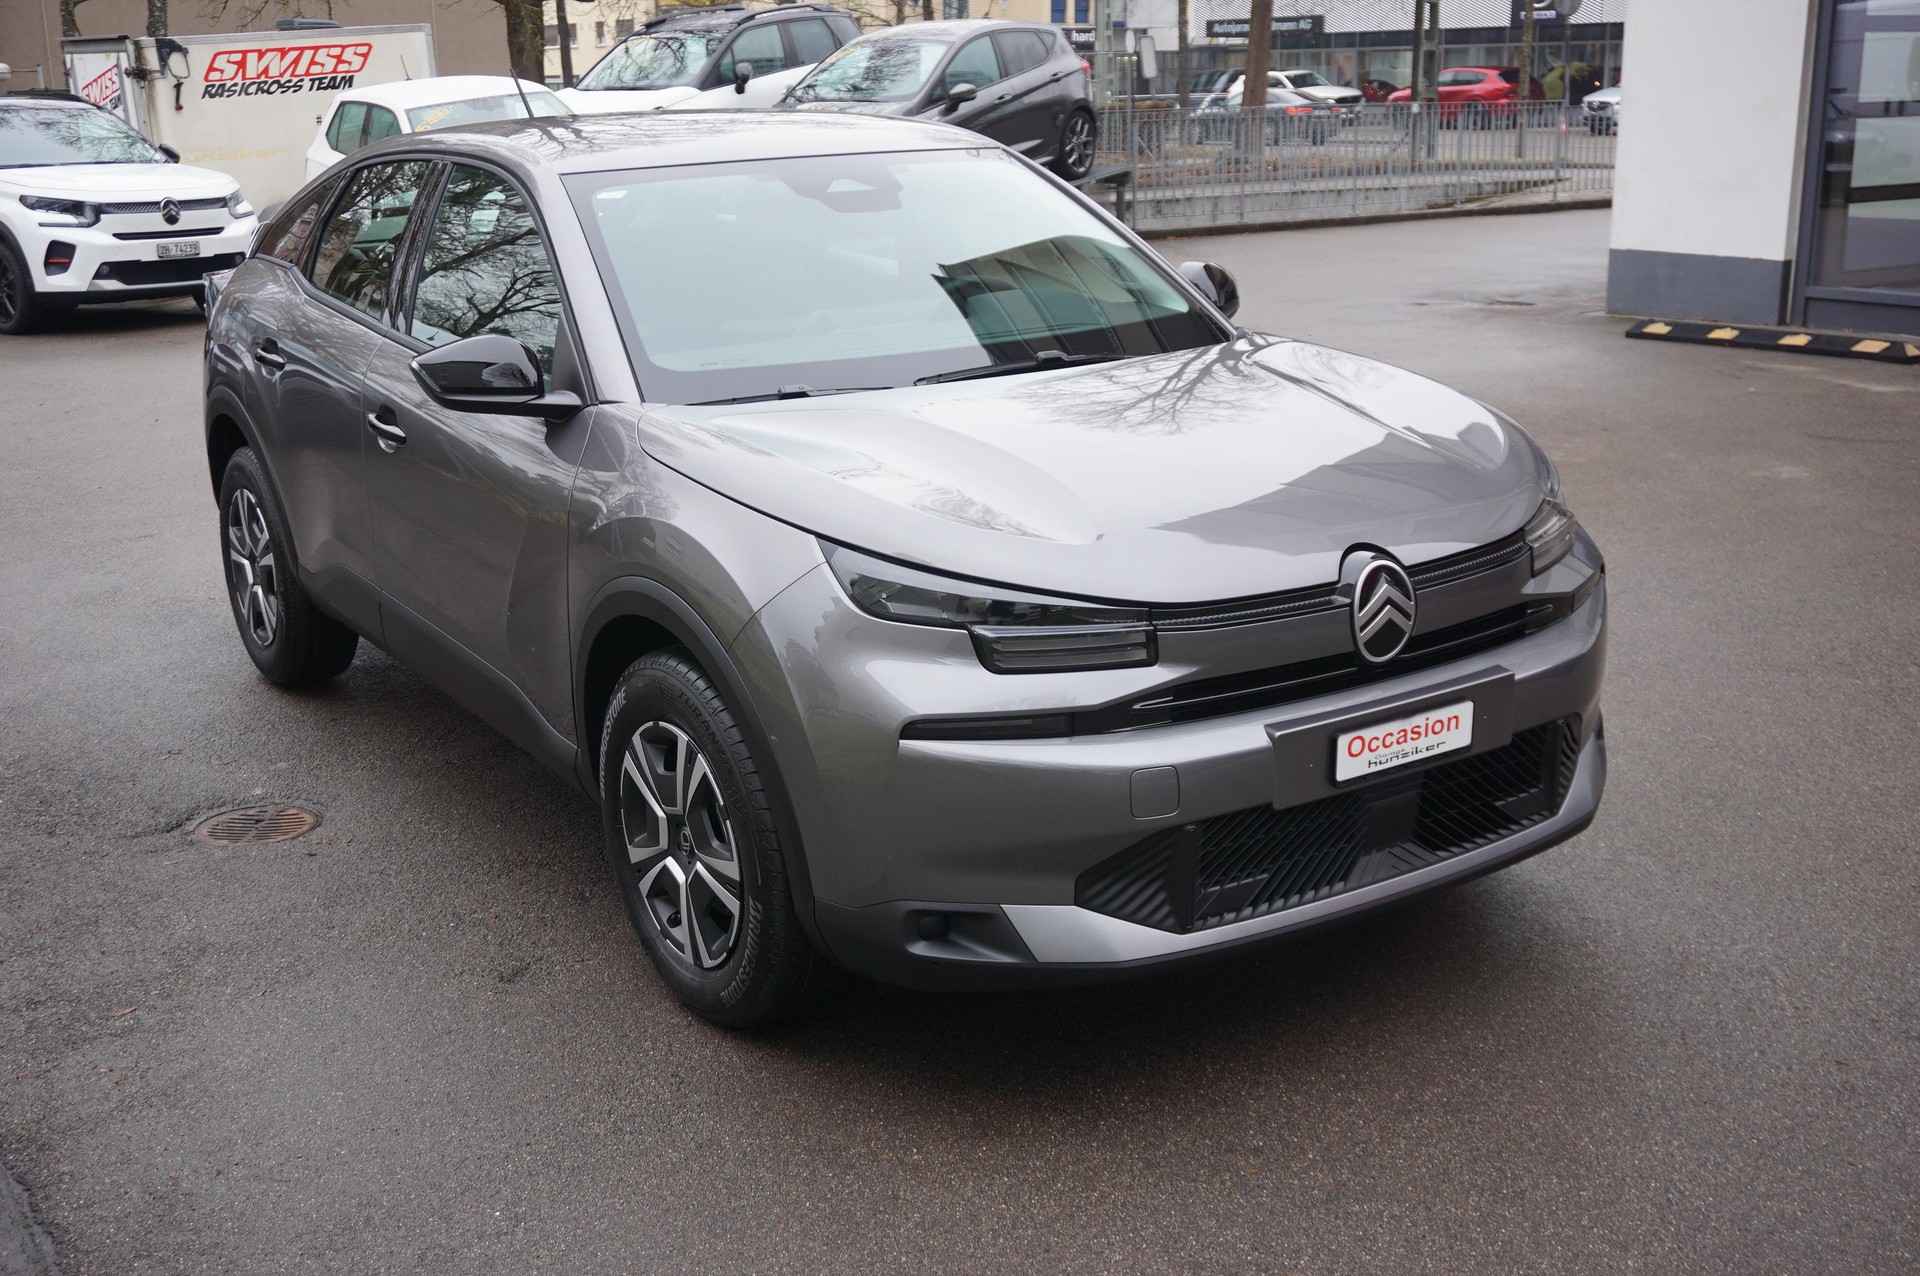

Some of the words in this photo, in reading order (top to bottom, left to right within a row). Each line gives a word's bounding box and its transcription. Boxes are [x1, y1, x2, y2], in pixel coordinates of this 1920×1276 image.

[204, 44, 373, 83] SWISS
[201, 78, 303, 100] RASICROSS
[308, 75, 355, 92] TEAM
[600, 686, 627, 801] BRIDGESTONE
[1347, 714, 1460, 758] Occasion
[1368, 741, 1446, 768] hunziker
[1375, 748, 1406, 760] Garage
[720, 895, 763, 1009] BRIDGESTONE
